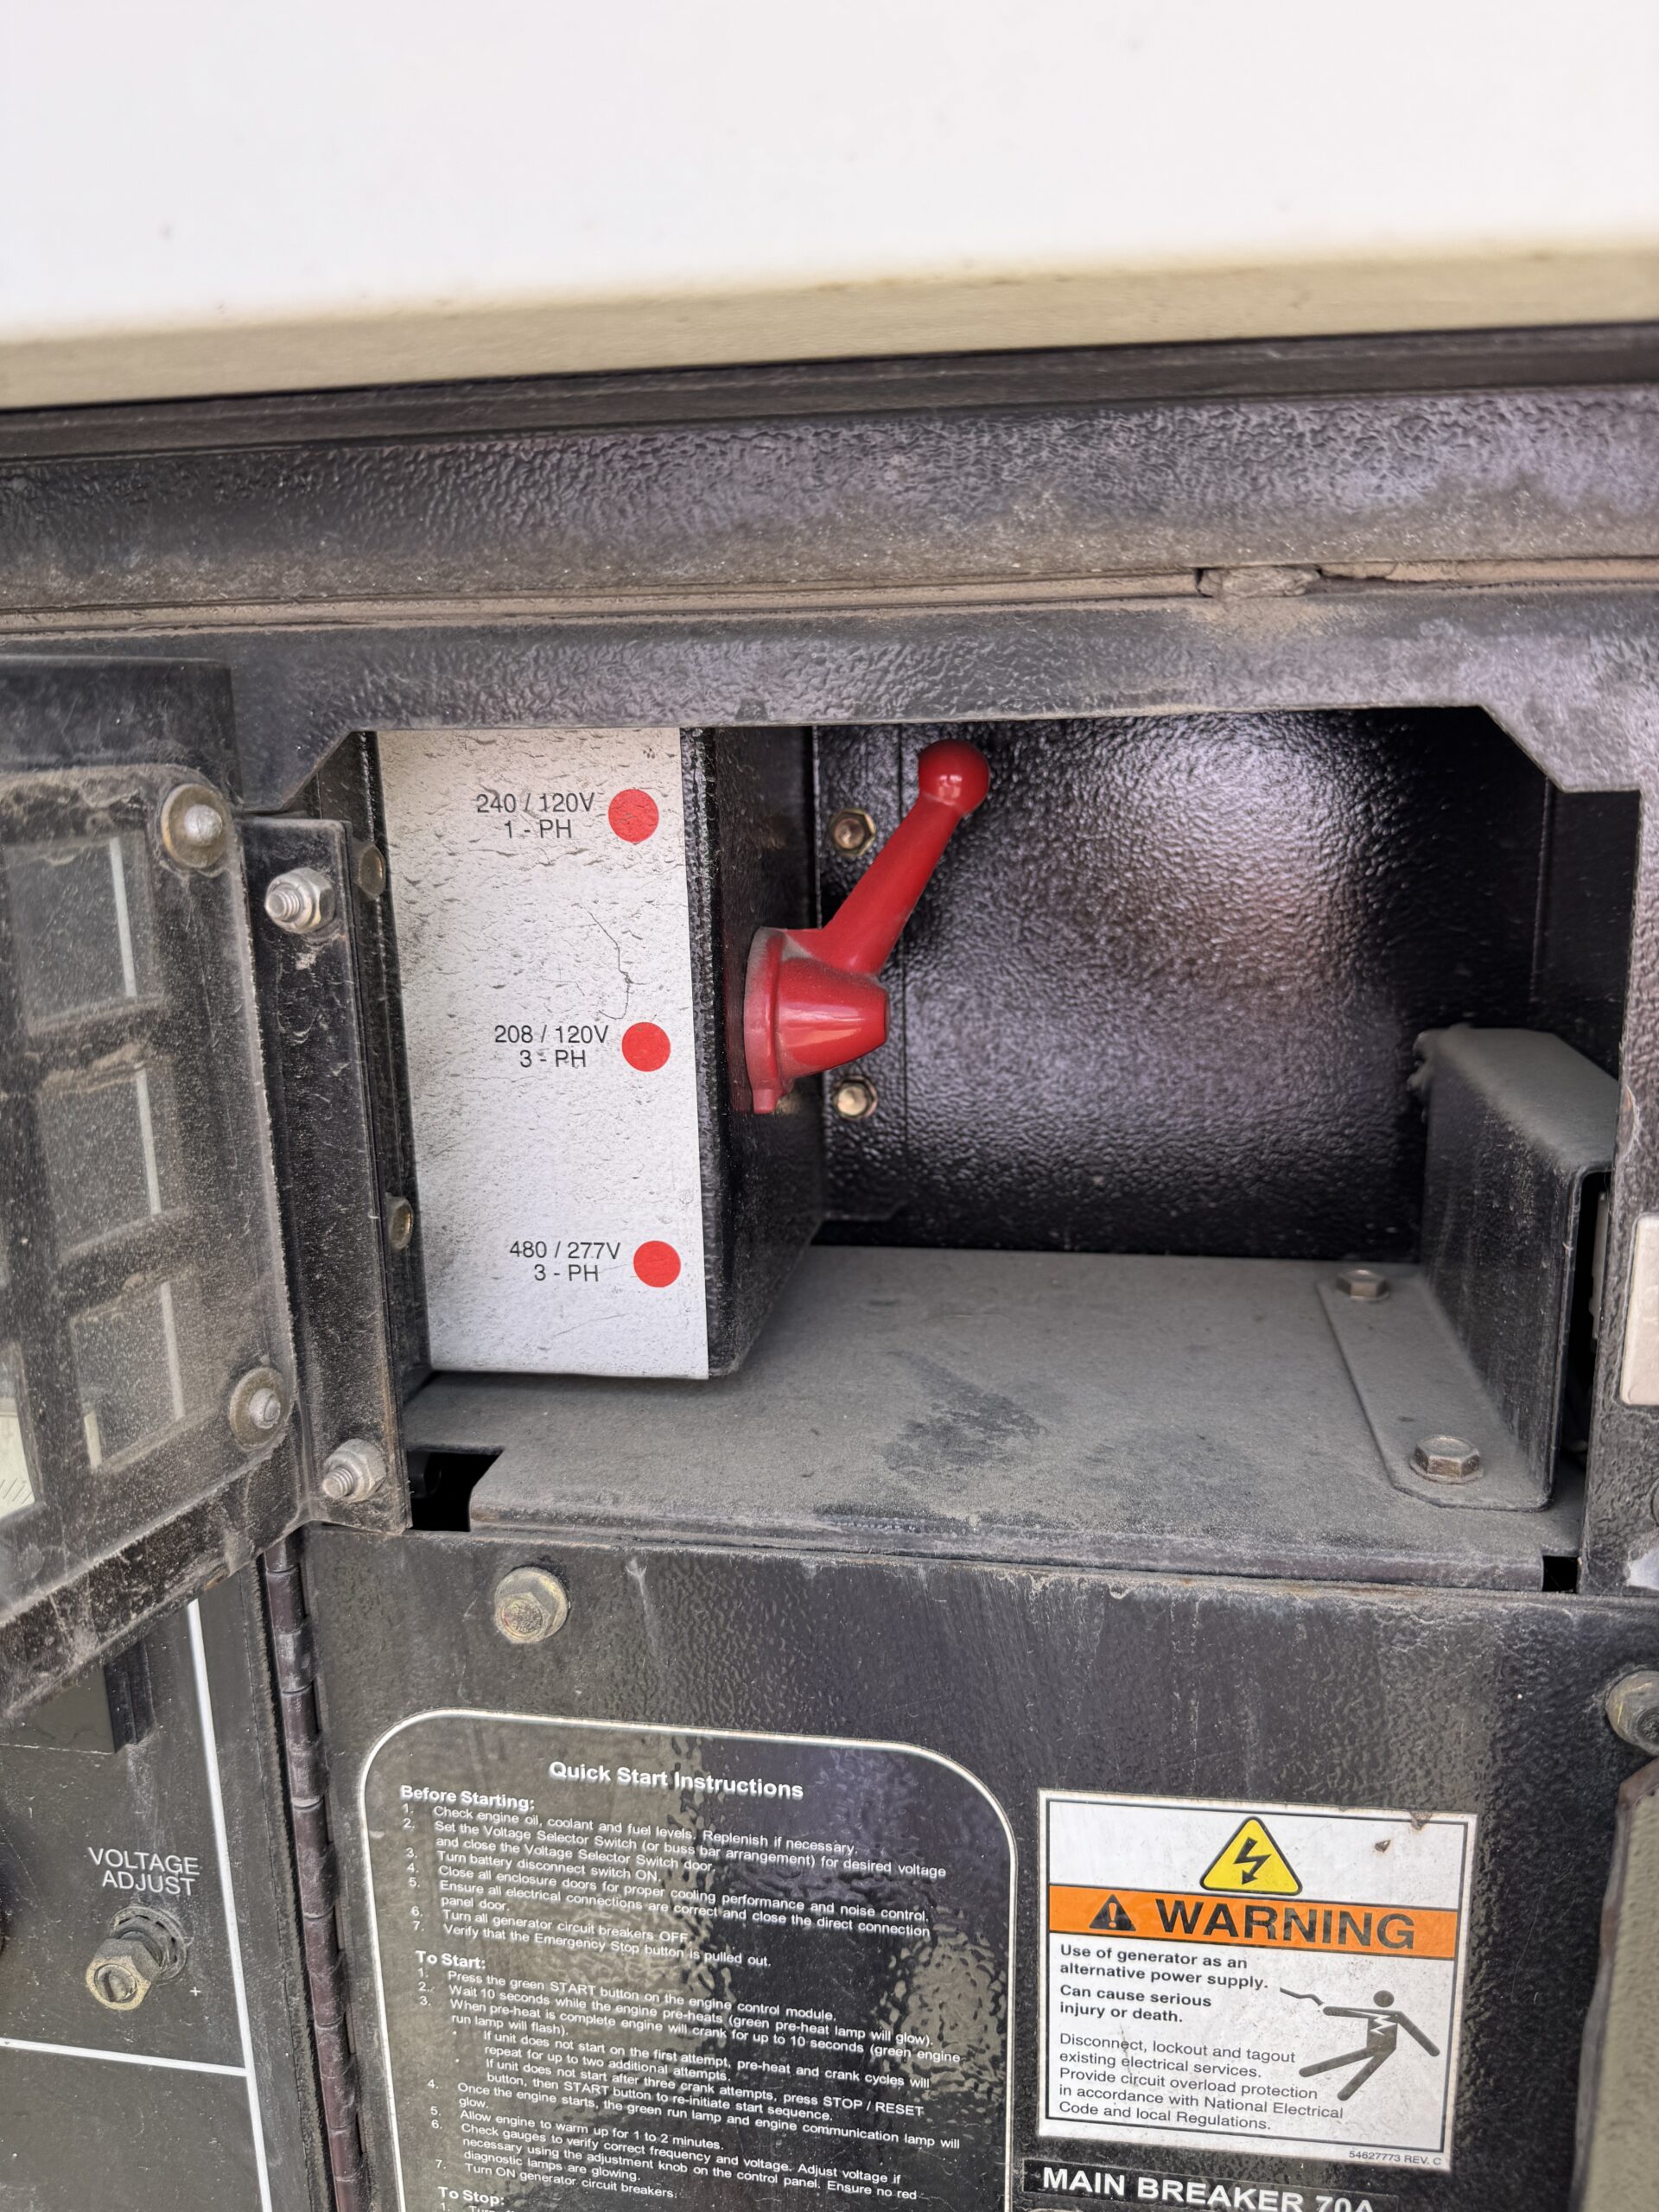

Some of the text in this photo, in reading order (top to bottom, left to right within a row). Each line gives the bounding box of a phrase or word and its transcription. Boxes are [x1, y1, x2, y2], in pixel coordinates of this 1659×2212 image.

[477, 793, 516, 813] 240
[539, 792, 594, 812] 120V
[505, 820, 512, 838] 1
[539, 819, 571, 838] PH
[495, 1025, 533, 1043] 208
[556, 1025, 608, 1044] 120V
[520, 1050, 531, 1068] 3
[556, 1050, 586, 1067] PH
[510, 1241, 547, 1258] 480
[568, 1242, 620, 1259] 277V
[534, 1264, 546, 1281] 3
[569, 1264, 599, 1281] PH
[548, 1761, 803, 1797] Quick Start Instructions
[399, 1784, 535, 1811] Before Starting:
[402, 1802, 858, 1857] 1. Check engine oil, coolant and fuel levels. Replenish if necessary.
[88, 1847, 200, 1875] VOLTAGE
[403, 1817, 946, 1879] 2. Set the Voltage Selector Switch (or buss bar arrangement) for desired voltage
[435, 1836, 715, 1871] and close the Voltage Selector Switch door.
[405, 1847, 661, 1881] 3. Turn battery disconnect switch ON.
[102, 1870, 195, 1896] ADJUST
[406, 1862, 929, 1922] 4. Close all enclosure doors for proper cooling performance and noise control.
[1155, 1898, 1414, 1949] WARNING
[416, 1950, 486, 1969] To Start:
[1061, 1944, 1247, 1968] Use of generator as an
[1060, 1963, 1268, 1991] alternative power supply.
[416, 1967, 836, 2021] 1. Press the green START button on the engine control module.
[1060, 1985, 1211, 2006] Can cause serious
[1060, 2002, 1182, 2022] injury or death.
[1060, 2033, 1295, 2064] Disconnect, lockout and tagout
[1059, 2051, 1262, 2078] existing electrical services.
[1059, 2068, 1318, 2100] Provide circuit overload protection
[1059, 2085, 1343, 2118] in accordance with National Electrical
[1059, 2101, 1271, 2130] Code and local Regulations.
[429, 2106, 724, 2150] 5. Allow engine to warm up for 1 to 2 minutes.
[1349, 2150, 1441, 2165] 54627773 REV. C
[435, 2159, 677, 2198] 7. Turn ON generator circuit breakers.
[1043, 2166, 1124, 2196] MAIN
[1138, 2177, 1302, 2212] BREAKER
[437, 2186, 505, 2208] To Stop:
